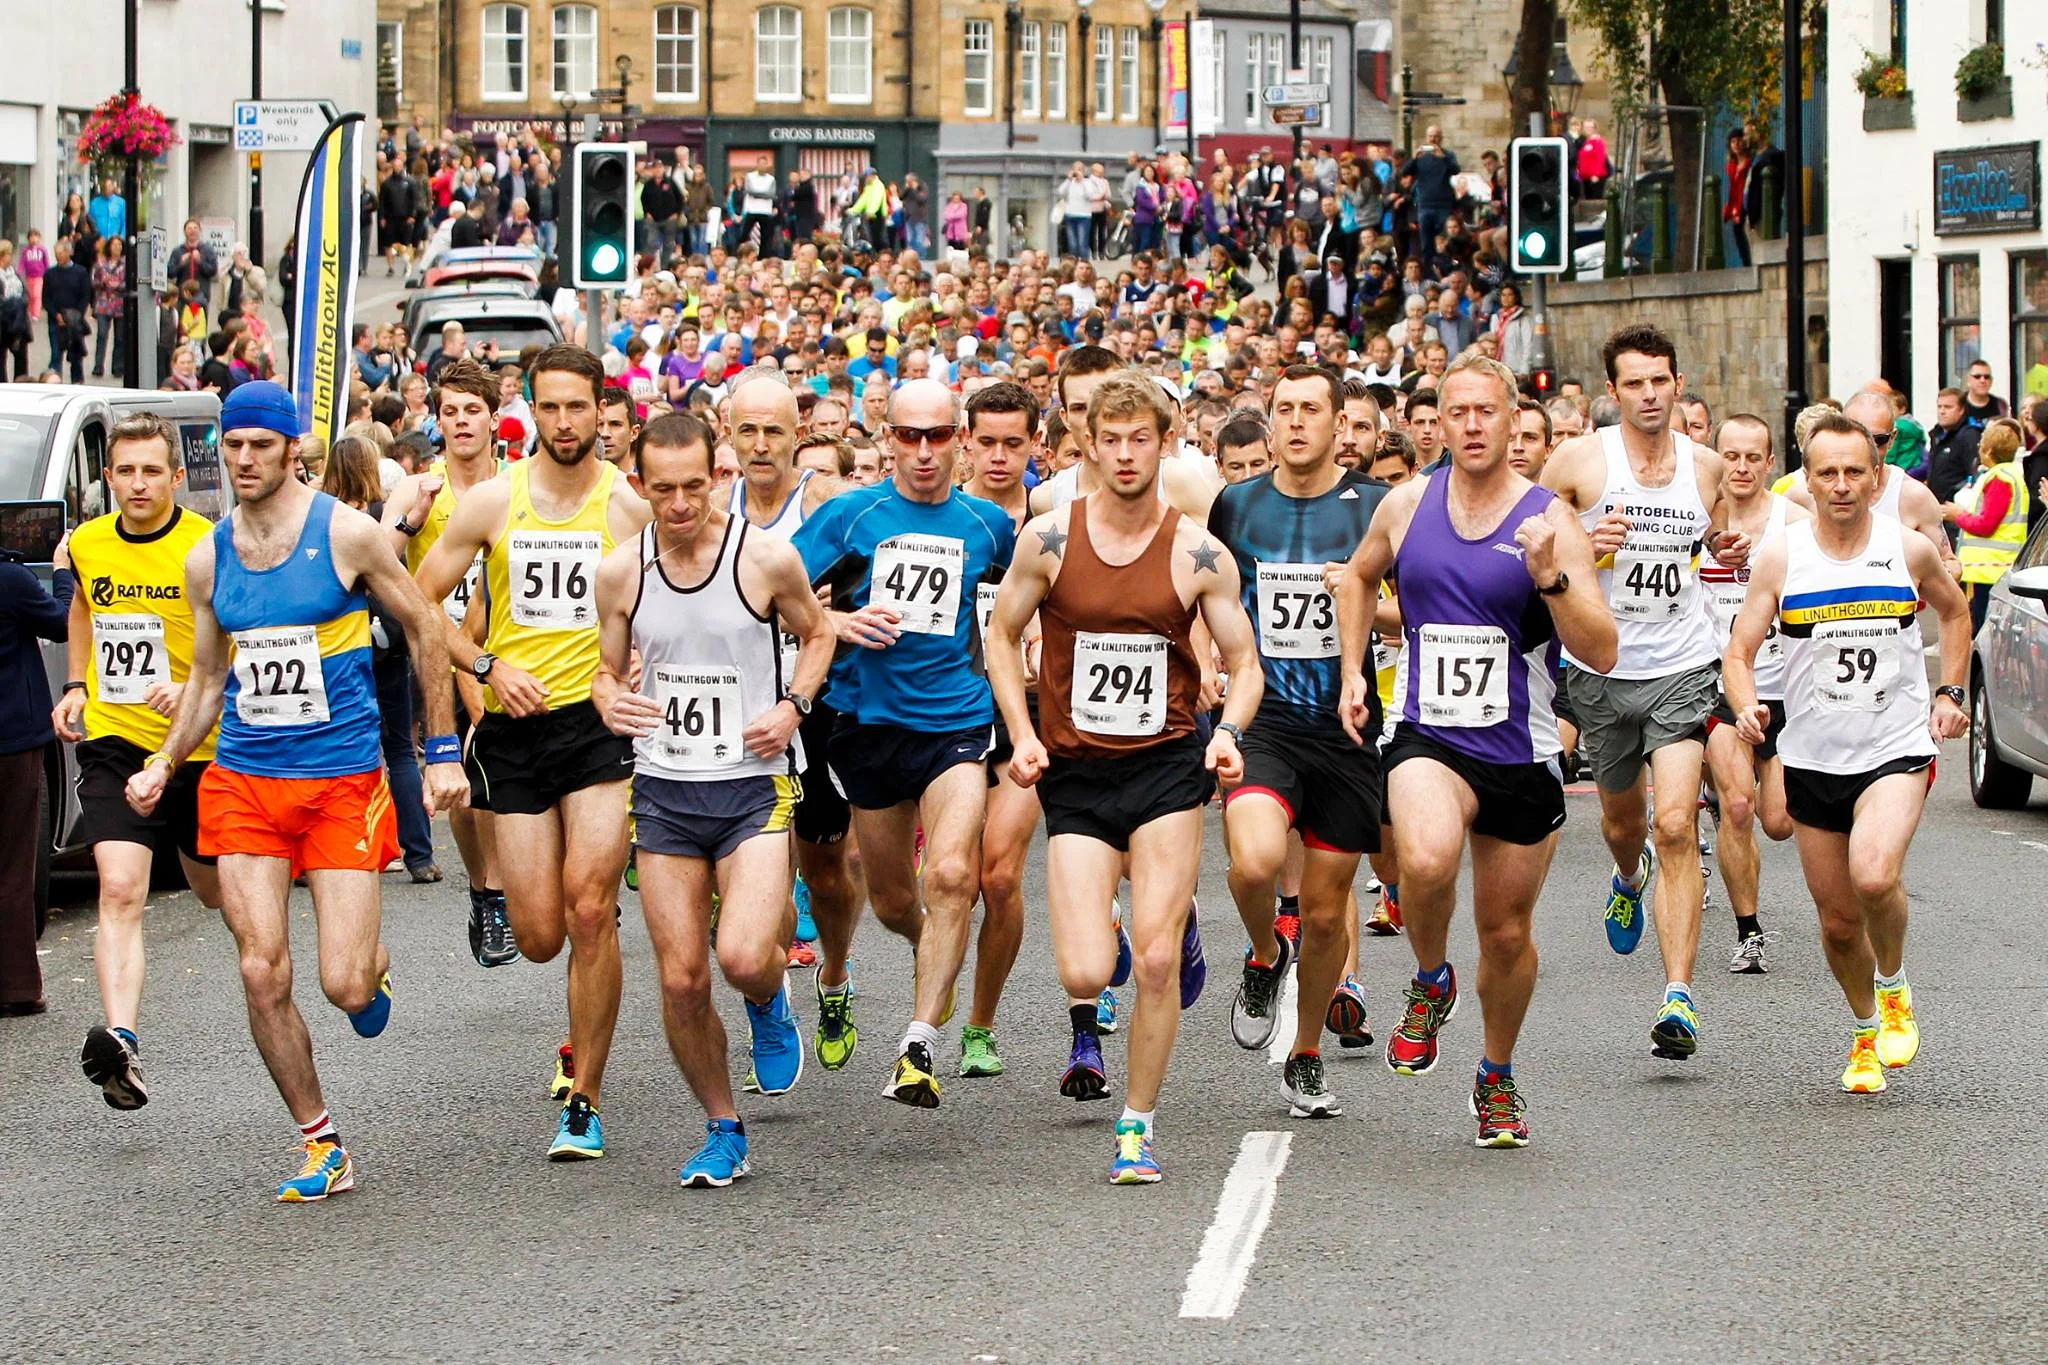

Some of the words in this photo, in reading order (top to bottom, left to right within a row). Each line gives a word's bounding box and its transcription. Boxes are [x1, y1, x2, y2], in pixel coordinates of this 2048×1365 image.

[242, 106, 256, 124] P
[261, 105, 314, 114] Weekends
[276, 117, 298, 126] only
[556, 121, 567, 133] &
[770, 127, 812, 140] CROSS
[814, 128, 875, 141] BARBERS
[322, 240, 337, 278] AC
[314, 284, 338, 425] Linlithgow
[187, 435, 217, 462] ASPIRE
[1605, 505, 1695, 520] PRTOBELLO
[1663, 524, 1693, 536] CLUB
[513, 540, 533, 549] CCW
[534, 540, 582, 549] LINLITHGOW
[585, 540, 598, 549] 10K
[900, 542, 947, 555] LINLITHGOW
[948, 548, 960, 557] 10K
[1620, 542, 1637, 551] CCW
[1639, 543, 1679, 552] LINLITHGOW
[523, 562, 587, 599] 516
[885, 563, 949, 604] 479
[1260, 572, 1279, 581] CCW
[1625, 562, 1682, 597] 440
[118, 585, 143, 598] RAT
[146, 586, 180, 599] RACE
[1719, 597, 1731, 605] CCW
[1272, 593, 1333, 630] 573
[1803, 603, 1877, 622] LINLITHGOW
[105, 621, 146, 631] LINLITHGOW
[148, 621, 162, 630] 10K
[1835, 628, 1883, 638] LINLITHGOW
[1885, 627, 1898, 636] 10K
[250, 637, 297, 649] LINLITHGOW
[300, 634, 314, 645] 10K
[1080, 640, 1100, 650] CCW
[1101, 642, 1152, 653] LINLITHGOW
[1153, 642, 1165, 652] 10K
[1423, 633, 1438, 643] CCW
[1440, 634, 1490, 645] LINLITHGOW
[1492, 635, 1507, 644] 10K
[102, 640, 156, 676] 292
[1836, 648, 1877, 684] 59
[250, 659, 309, 696] 122
[671, 674, 720, 684] LINLITHGOW
[722, 675, 737, 685] 10K
[1088, 663, 1153, 705] 294
[1437, 656, 1496, 697] 157
[665, 696, 721, 736] 461
